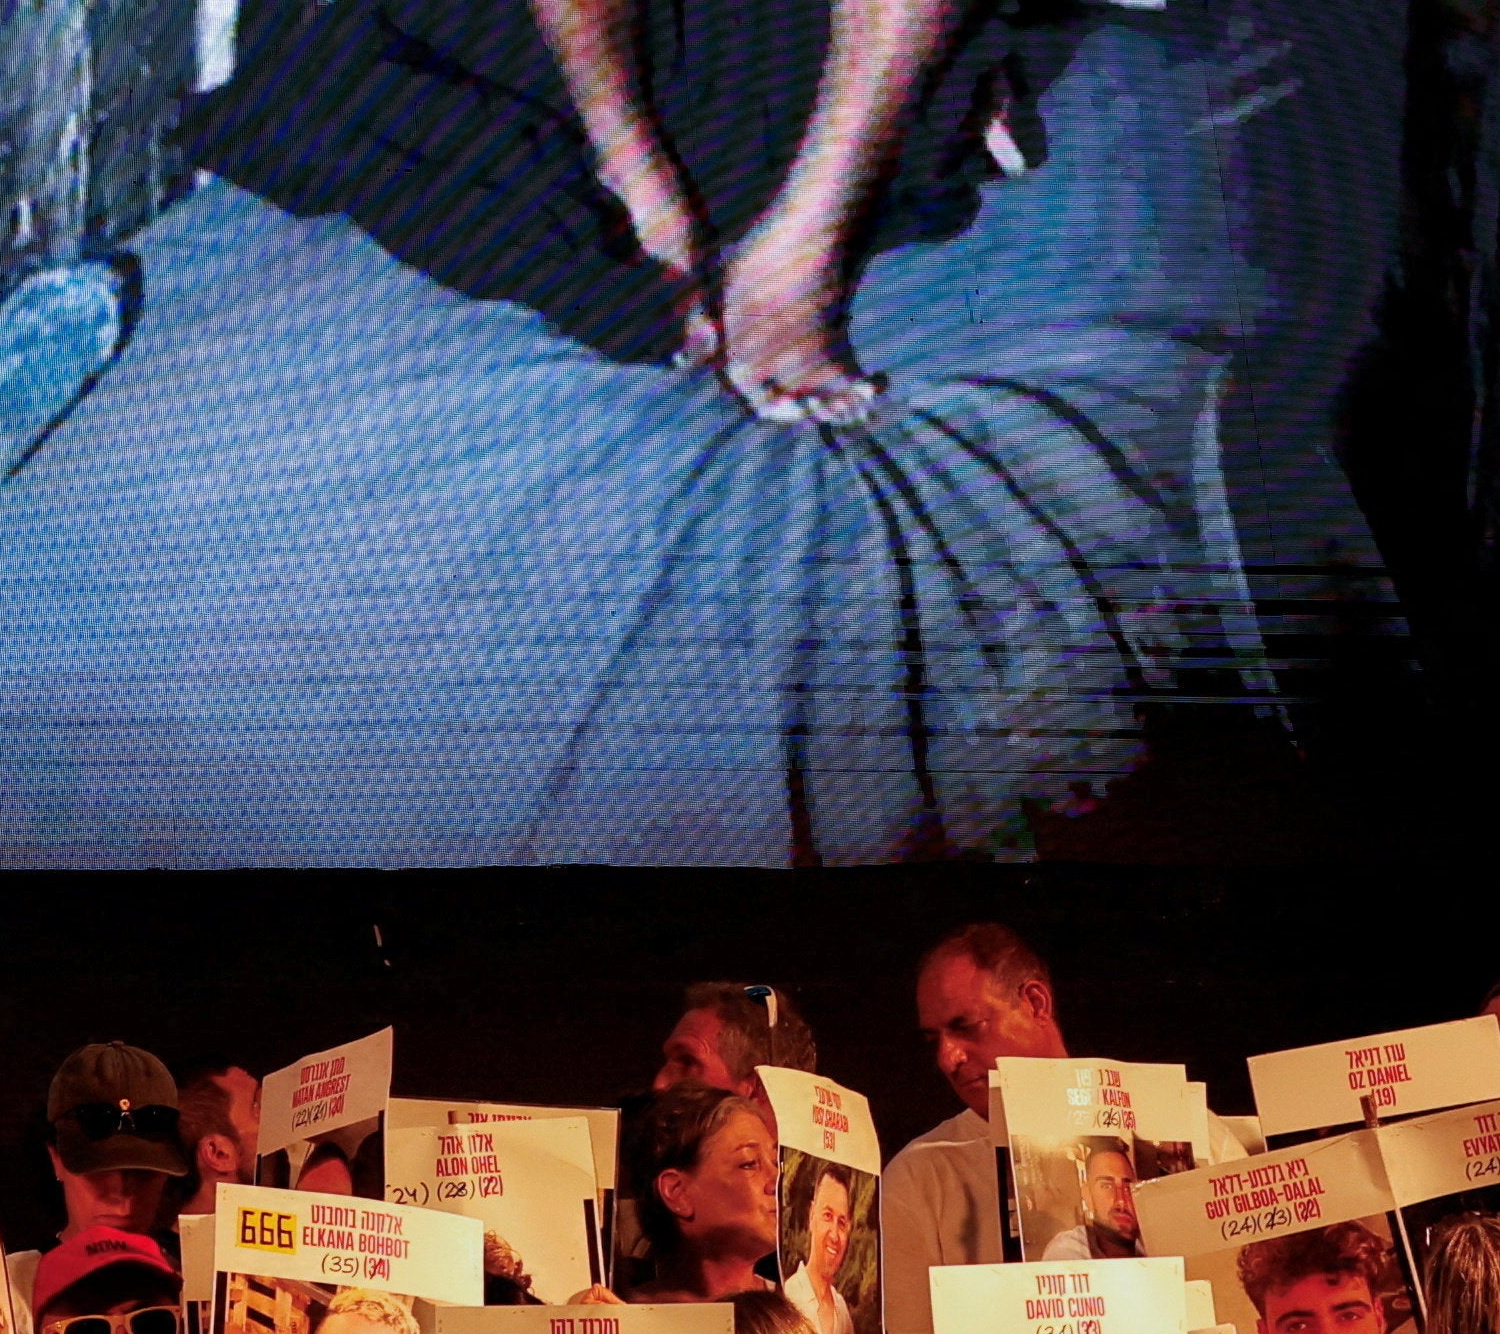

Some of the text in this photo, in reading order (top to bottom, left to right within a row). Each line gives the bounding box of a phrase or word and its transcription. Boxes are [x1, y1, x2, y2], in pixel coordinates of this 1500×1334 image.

[1345, 1049, 1379, 1069] דניאל
[1349, 1064, 1412, 1090] OZ DANIEL
[436, 1154, 500, 1177] ALON OHEL
[1205, 1178, 1325, 1218] GUY GILBOA-DALAL
[310, 1206, 403, 1235] אלקנה בוחבוט
[303, 1227, 409, 1258] ELKANA BOHBOT
[1026, 1296, 1105, 1319] DAVID CUNIO
